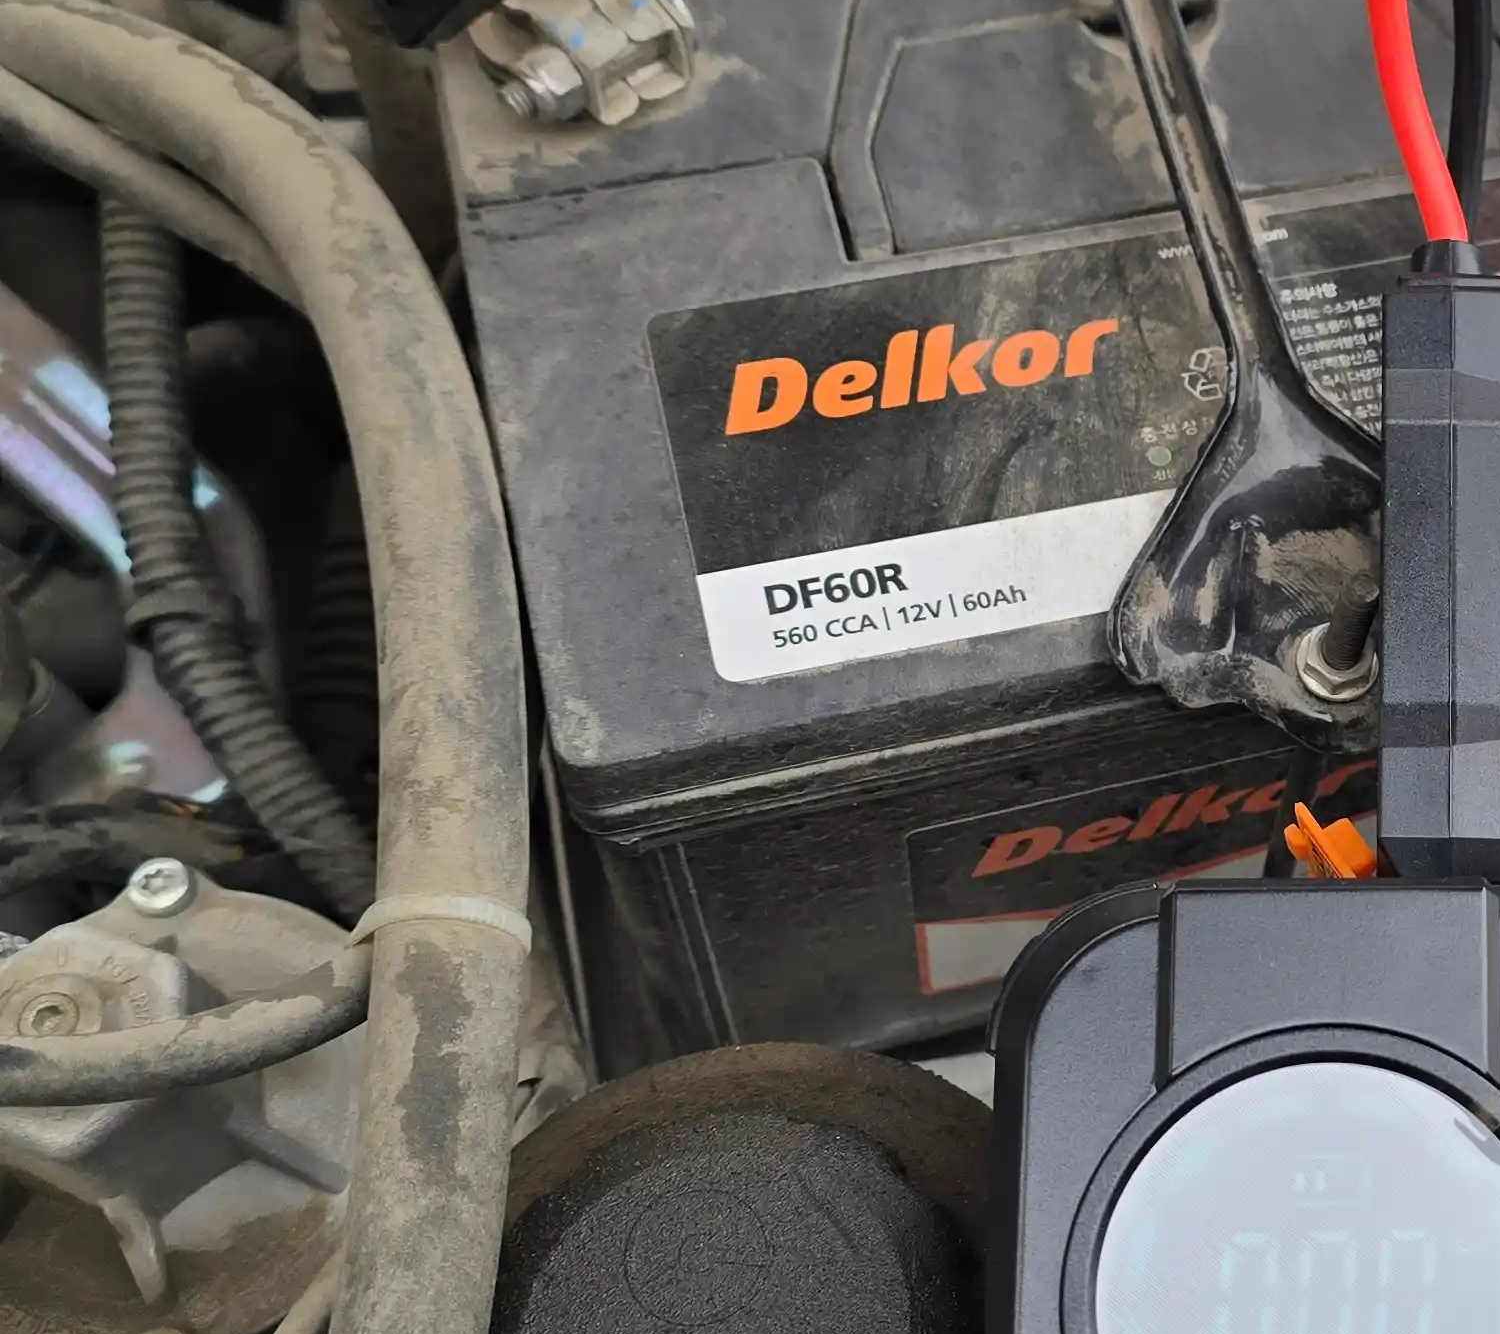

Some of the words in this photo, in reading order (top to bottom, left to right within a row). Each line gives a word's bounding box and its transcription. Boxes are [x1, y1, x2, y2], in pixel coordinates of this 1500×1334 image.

[725, 318, 1118, 436] Delkor
[763, 562, 909, 616] DF60R
[773, 624, 818, 648] 560
[825, 613, 878, 638] CCA
[897, 599, 942, 624] 12V
[963, 584, 1027, 612] 60Ah
